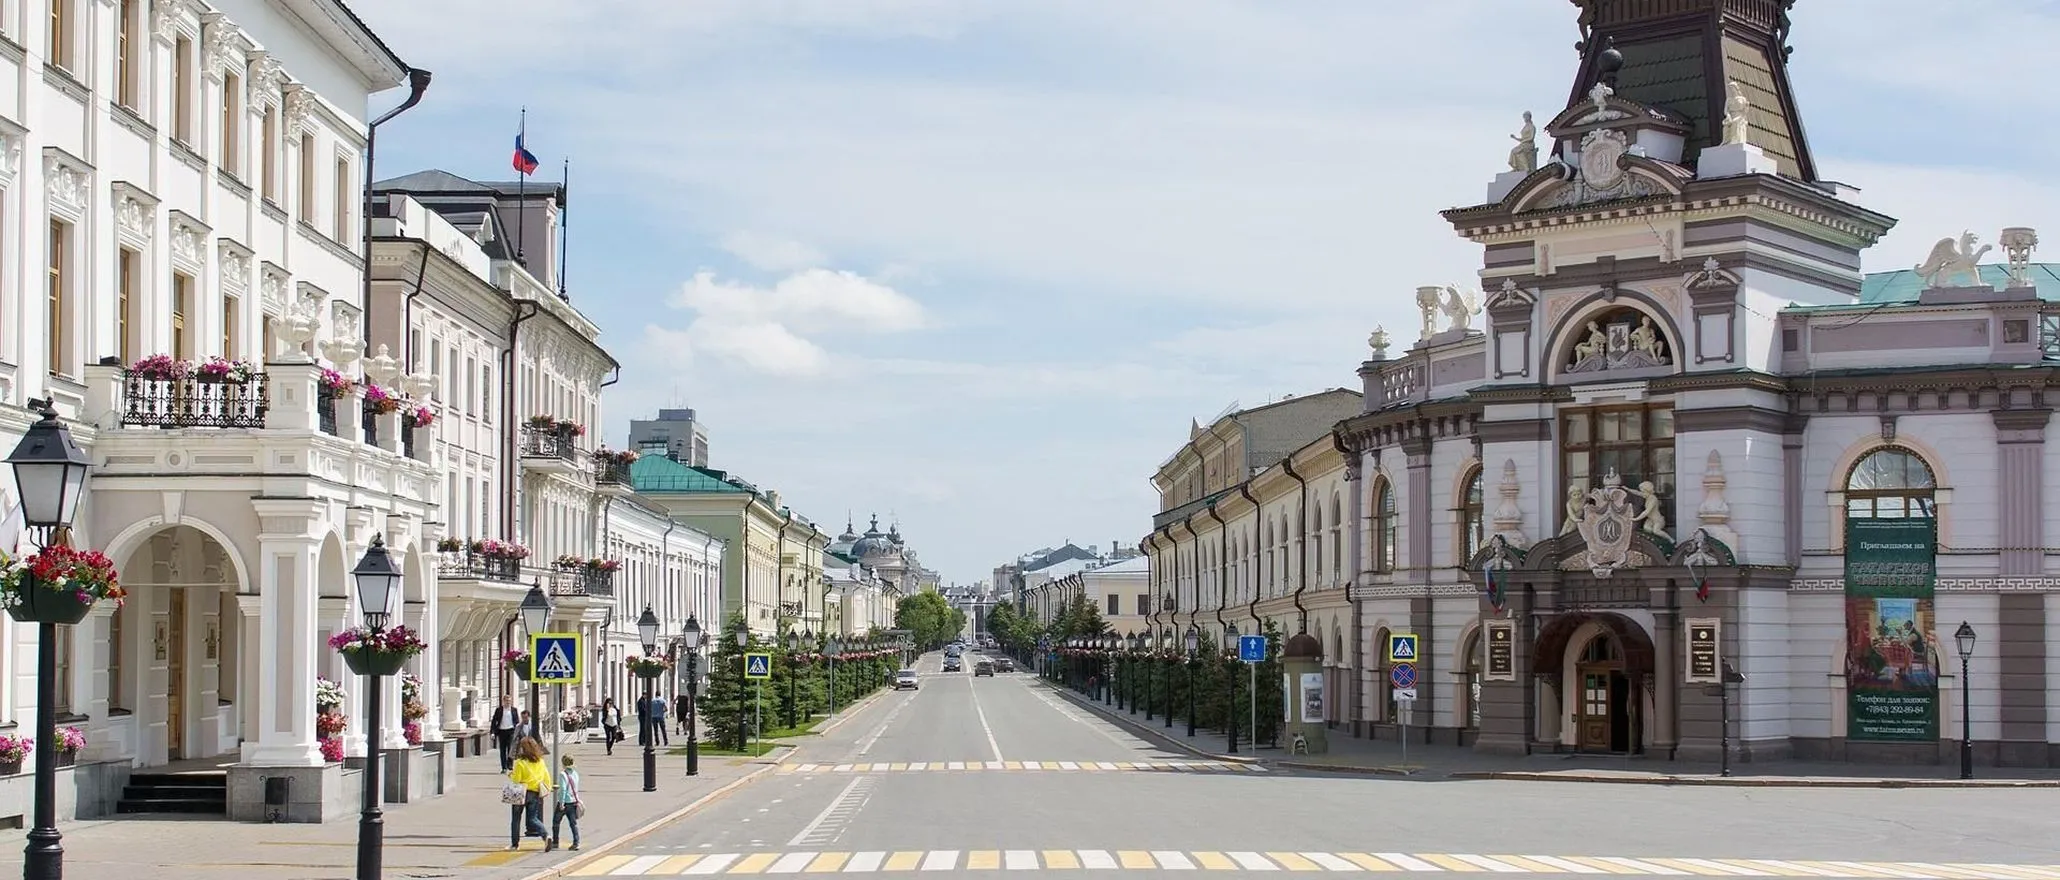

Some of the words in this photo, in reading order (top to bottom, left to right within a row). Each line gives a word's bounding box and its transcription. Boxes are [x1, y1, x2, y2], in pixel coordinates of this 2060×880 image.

[1860, 541, 1912, 550] Приглашаем
[1850, 562, 1929, 574] ТАТАРСКОЕ
[1856, 694, 1886, 705] Телефон
